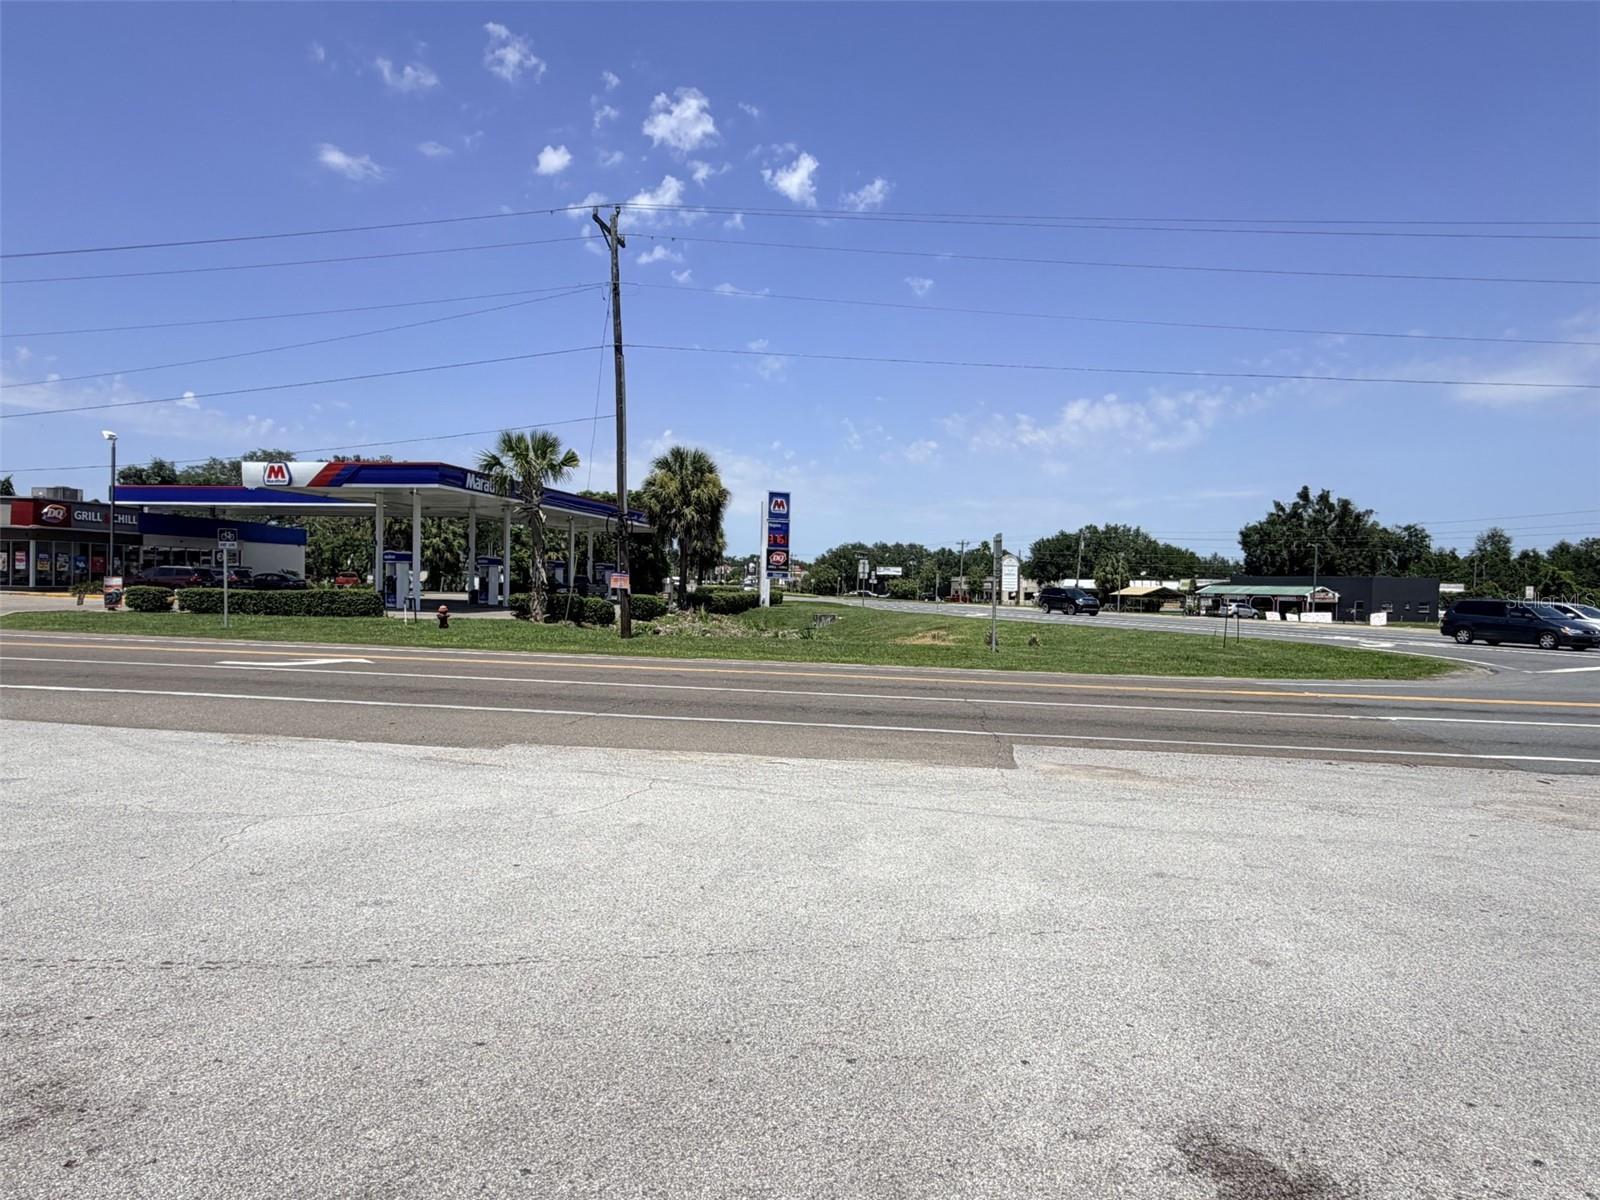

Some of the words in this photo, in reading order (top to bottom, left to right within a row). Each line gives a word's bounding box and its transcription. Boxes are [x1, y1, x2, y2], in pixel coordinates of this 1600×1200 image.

[267, 465, 285, 479] M
[47, 508, 64, 519] DQ
[74, 510, 103, 522] GRILL
